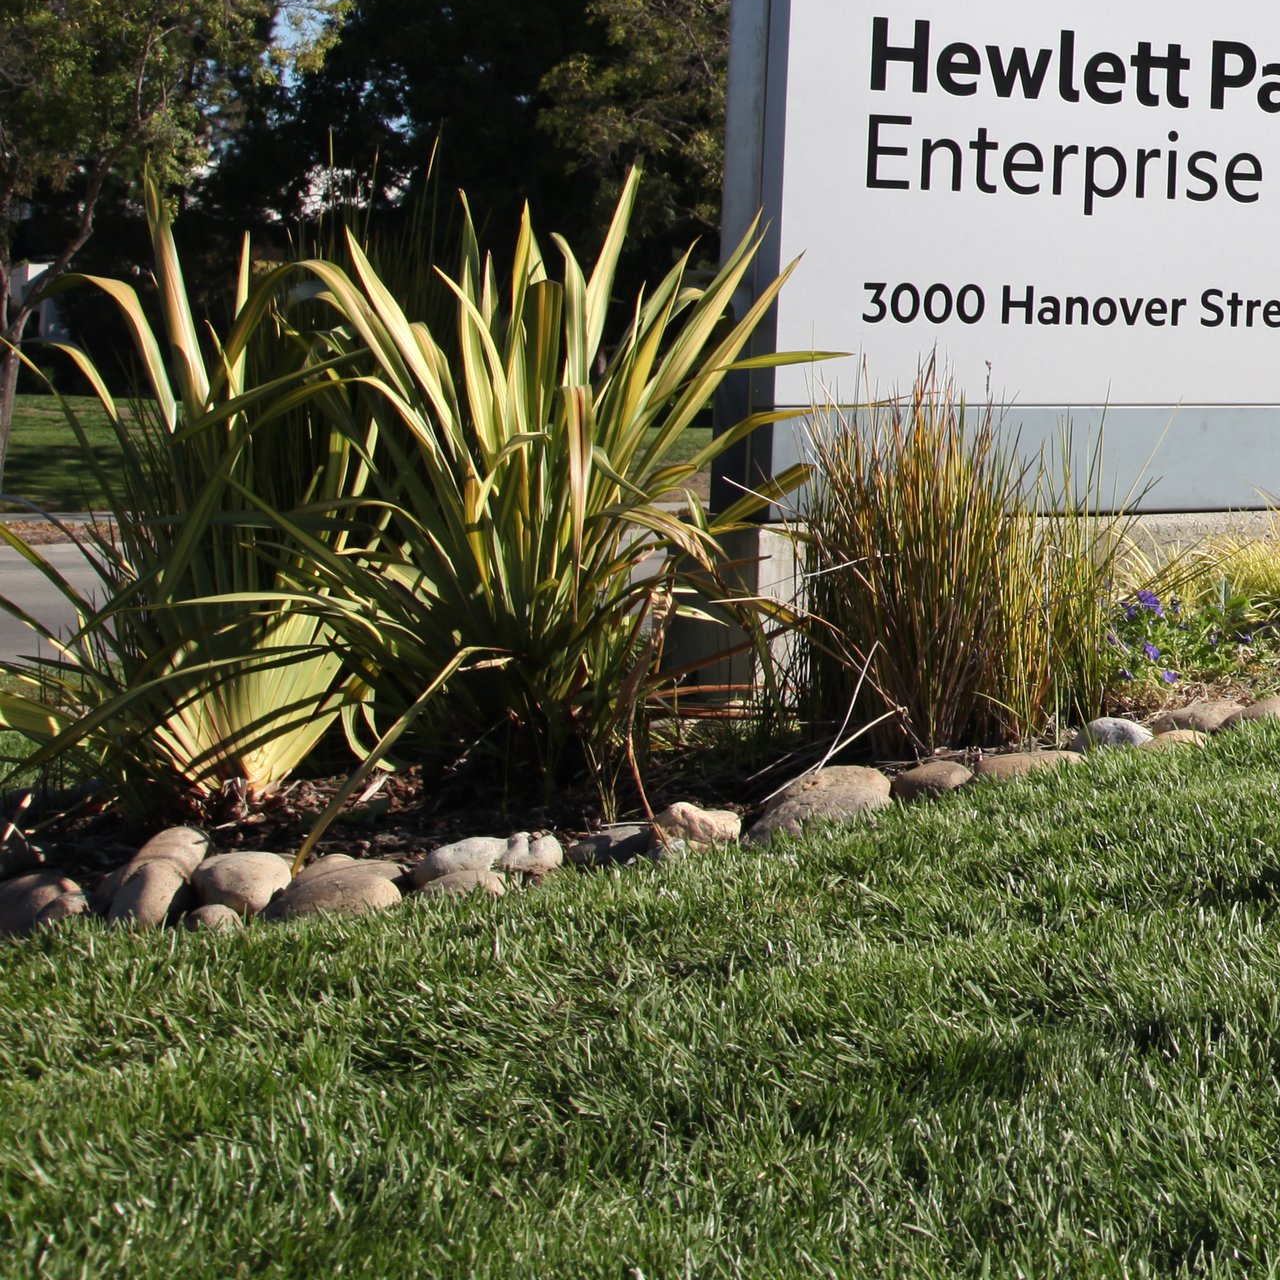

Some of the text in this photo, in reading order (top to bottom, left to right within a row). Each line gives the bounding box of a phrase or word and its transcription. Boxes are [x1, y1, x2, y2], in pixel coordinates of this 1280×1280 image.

[870, 16, 1191, 110] Hewlett
[866, 114, 1263, 216] Enterprise
[862, 282, 985, 325] 3000
[1001, 284, 1187, 327] Hanover
